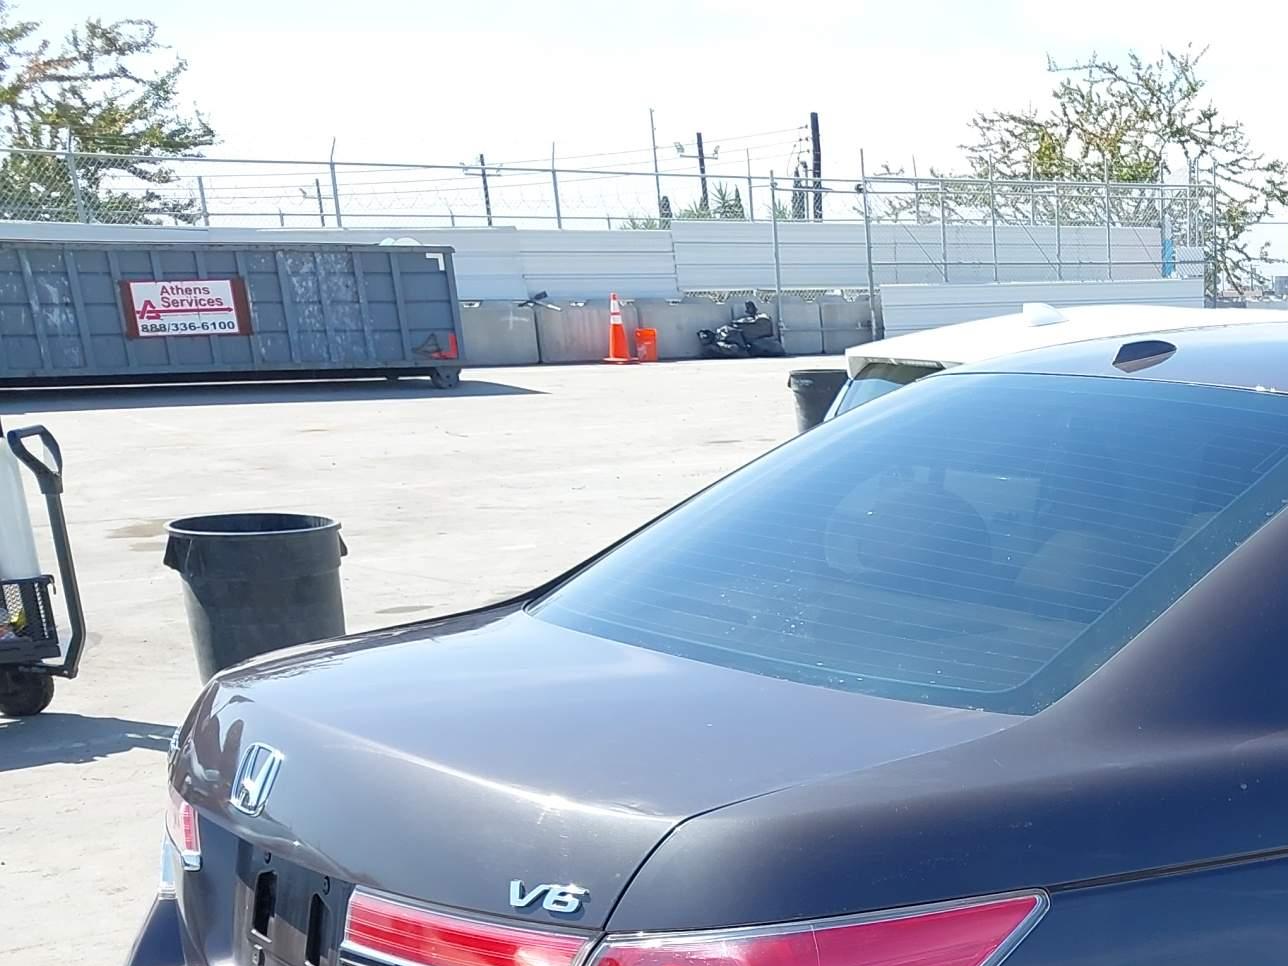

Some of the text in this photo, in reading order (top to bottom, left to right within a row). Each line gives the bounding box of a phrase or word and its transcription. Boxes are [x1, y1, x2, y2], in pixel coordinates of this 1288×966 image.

[160, 285, 210, 296] Athens
[161, 296, 224, 308] Services
[140, 320, 235, 333] 888/336-6100
[509, 879, 590, 913] V6
